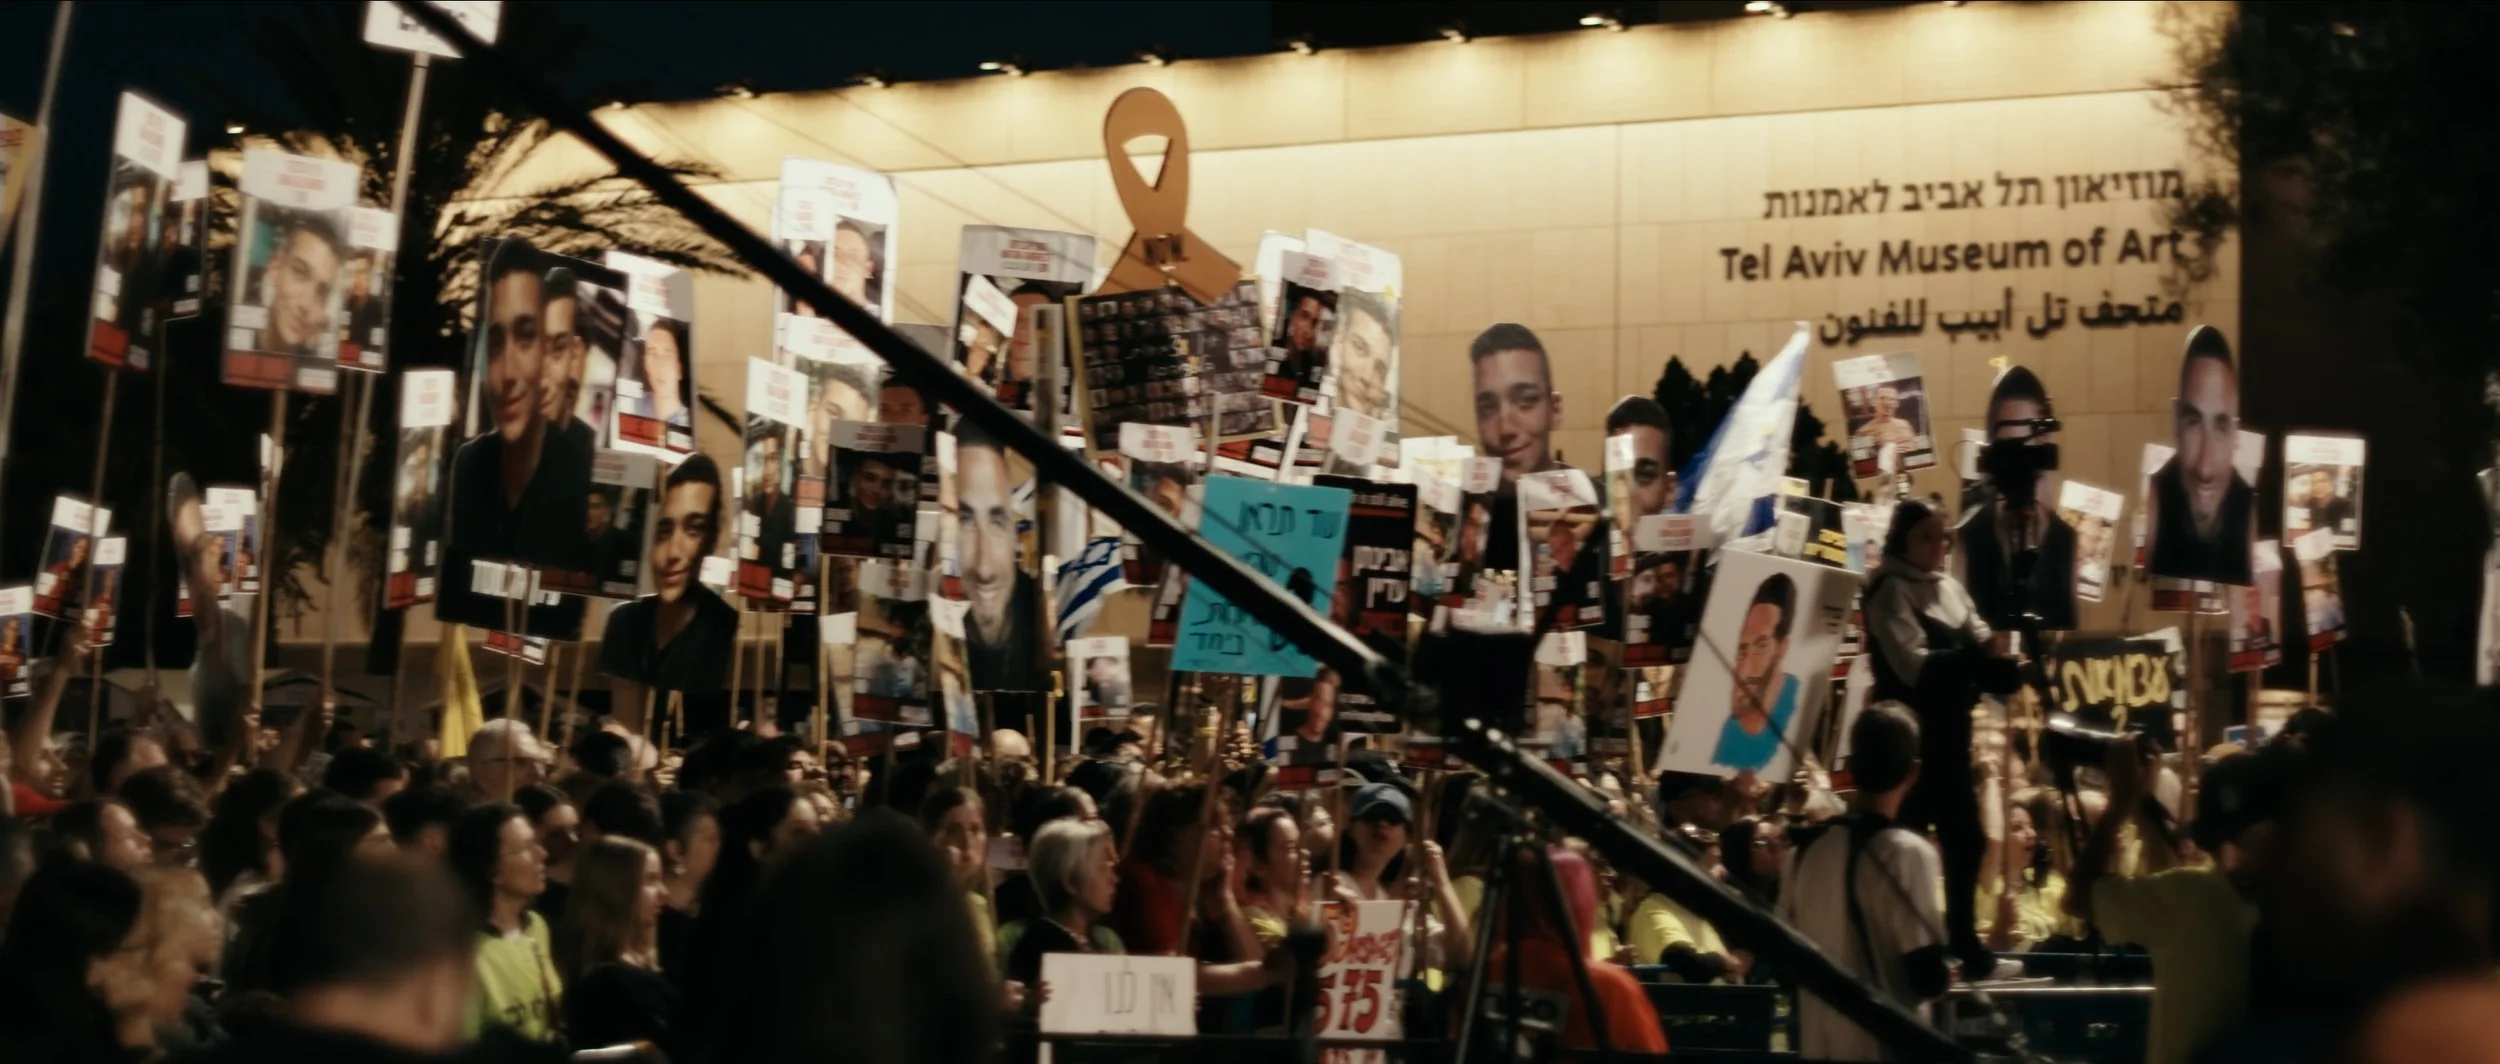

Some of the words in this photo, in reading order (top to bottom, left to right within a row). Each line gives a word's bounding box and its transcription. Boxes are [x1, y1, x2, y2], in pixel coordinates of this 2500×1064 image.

[1764, 178, 1889, 220] לאמנות
[1902, 179, 1983, 212] אביב
[1995, 171, 2042, 206] תל
[2054, 169, 2184, 209] מוזיאון
[1720, 244, 1771, 282] Tel
[1783, 243, 1867, 279] Aviv
[1879, 239, 2050, 276] Museum
[2064, 227, 2106, 265] of
[2118, 229, 2184, 265] Art
[1820, 298, 1926, 347] للفنون
[1938, 287, 2013, 344] أبيب
[2026, 292, 2067, 339] تل
[2079, 289, 2184, 330] متحف
